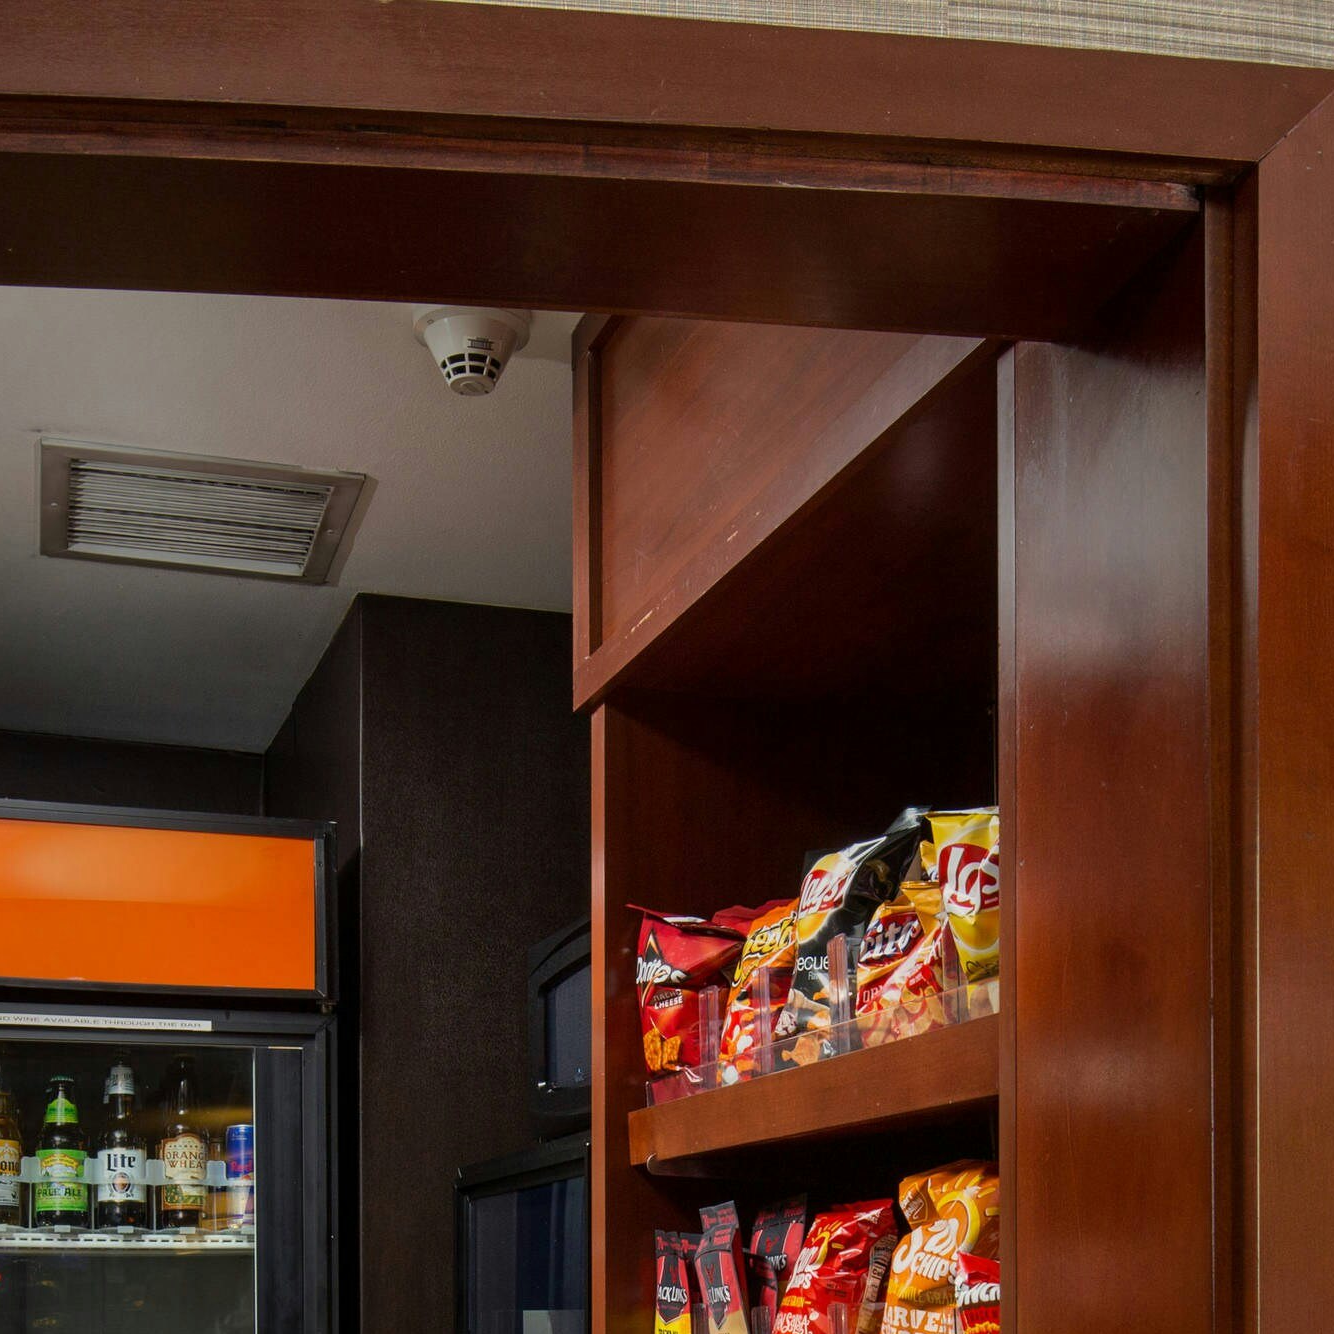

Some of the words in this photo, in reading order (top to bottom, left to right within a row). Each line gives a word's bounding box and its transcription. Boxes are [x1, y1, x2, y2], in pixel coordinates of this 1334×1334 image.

[796, 955, 830, 972] ecue
[654, 996, 684, 1010] CHEESE
[107, 1153, 136, 1172] Lite
[167, 1151, 204, 1161] ORANG
[169, 1159, 203, 1169] WHEA
[37, 1188, 60, 1197] PALE
[64, 1187, 82, 1197] ALE
[658, 1284, 672, 1302] ACK
